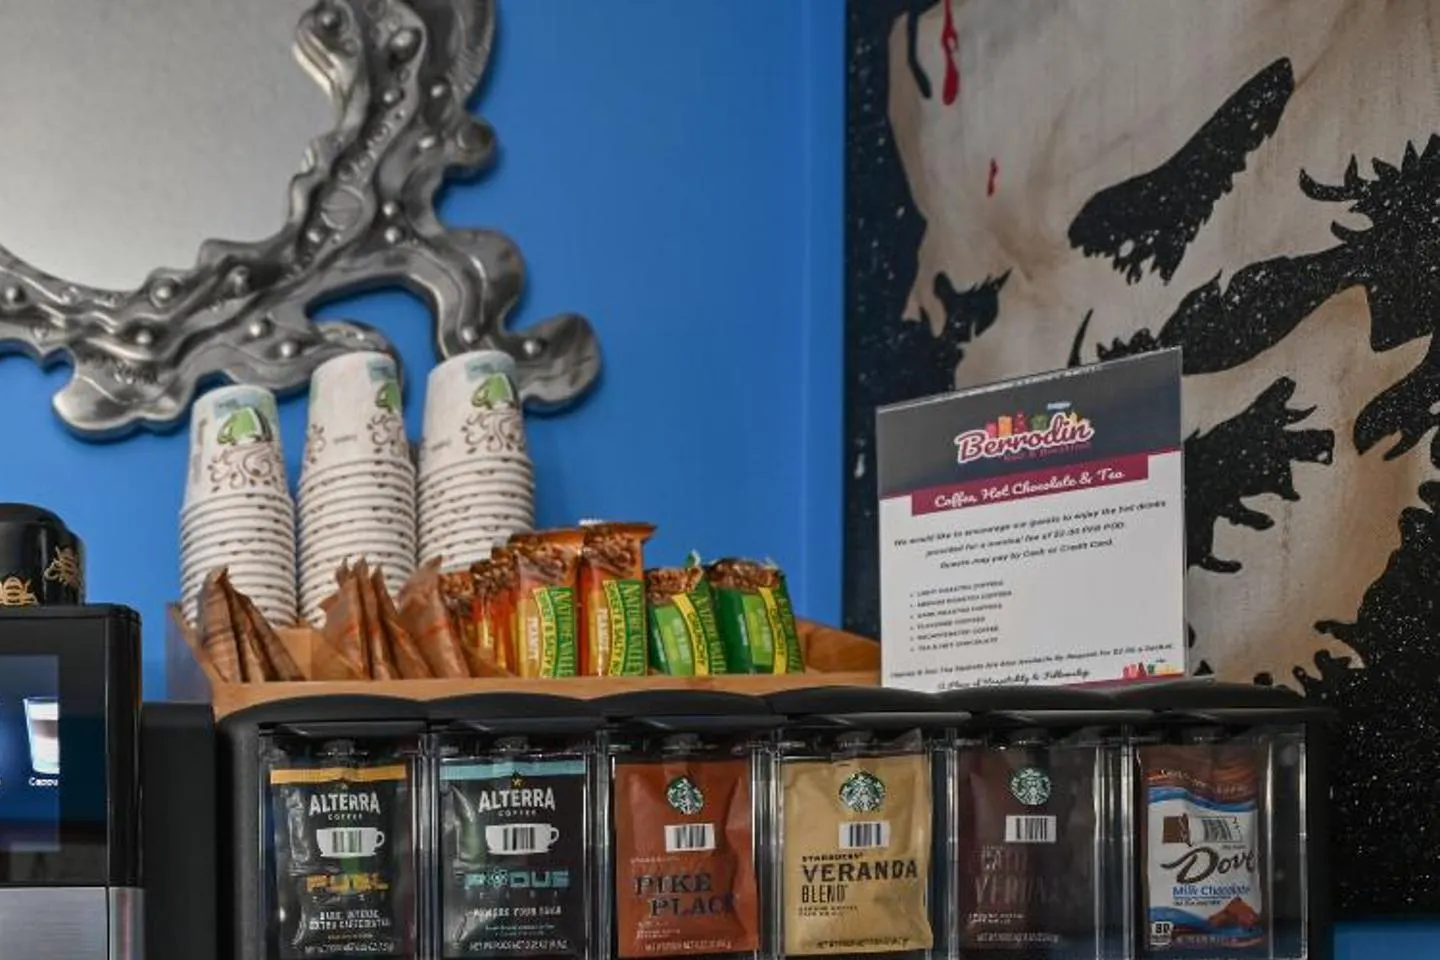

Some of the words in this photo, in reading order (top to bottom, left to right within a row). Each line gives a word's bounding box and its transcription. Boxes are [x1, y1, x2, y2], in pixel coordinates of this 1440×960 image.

[954, 412, 1096, 464] Berrodin
[981, 484, 1010, 501] Hot
[1012, 476, 1077, 496] Chocolate
[1079, 471, 1093, 485] &
[1096, 467, 1125, 480] Tea
[28, 777, 58, 787] Cappu
[309, 792, 380, 816] ALTERRA
[478, 787, 556, 813] ALTERRA
[801, 860, 918, 882] VERANDA
[635, 872, 712, 895] PIKE
[801, 884, 847, 904] BLEND
[1173, 885, 1198, 896] Milk
